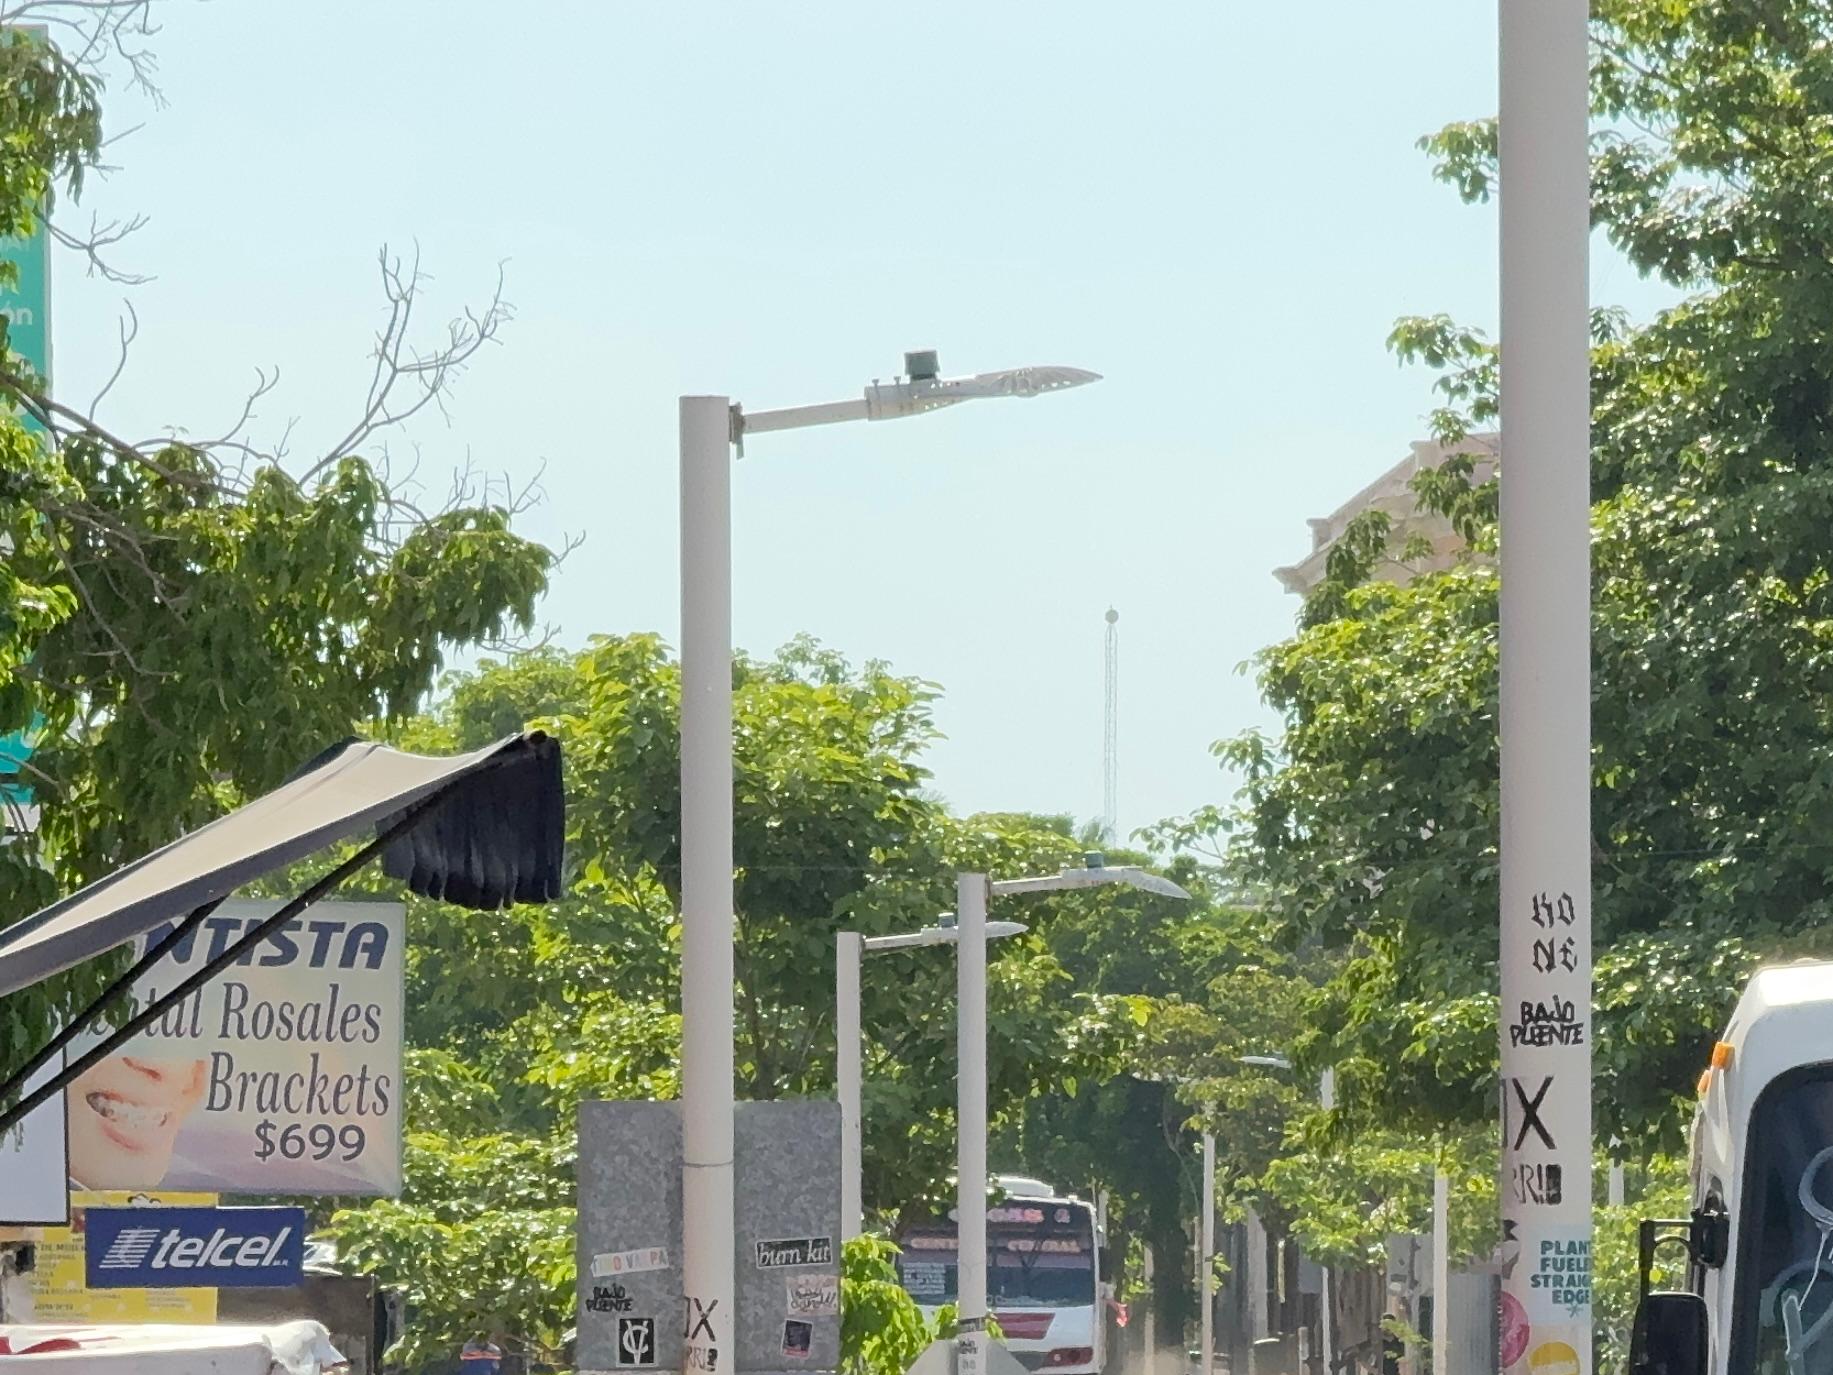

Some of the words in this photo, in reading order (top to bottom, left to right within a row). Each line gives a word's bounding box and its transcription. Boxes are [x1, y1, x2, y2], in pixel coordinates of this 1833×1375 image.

[143, 917, 390, 970] NTISTA
[218, 981, 381, 1044] Rosales
[1520, 995, 1575, 1026] BAJO
[1510, 1022, 1584, 1047] PUENTE
[205, 1051, 391, 1118] Brackets
[254, 1119, 366, 1162] $699
[151, 1226, 292, 1270] telcel
[1551, 1289, 1590, 1305] EDGE
